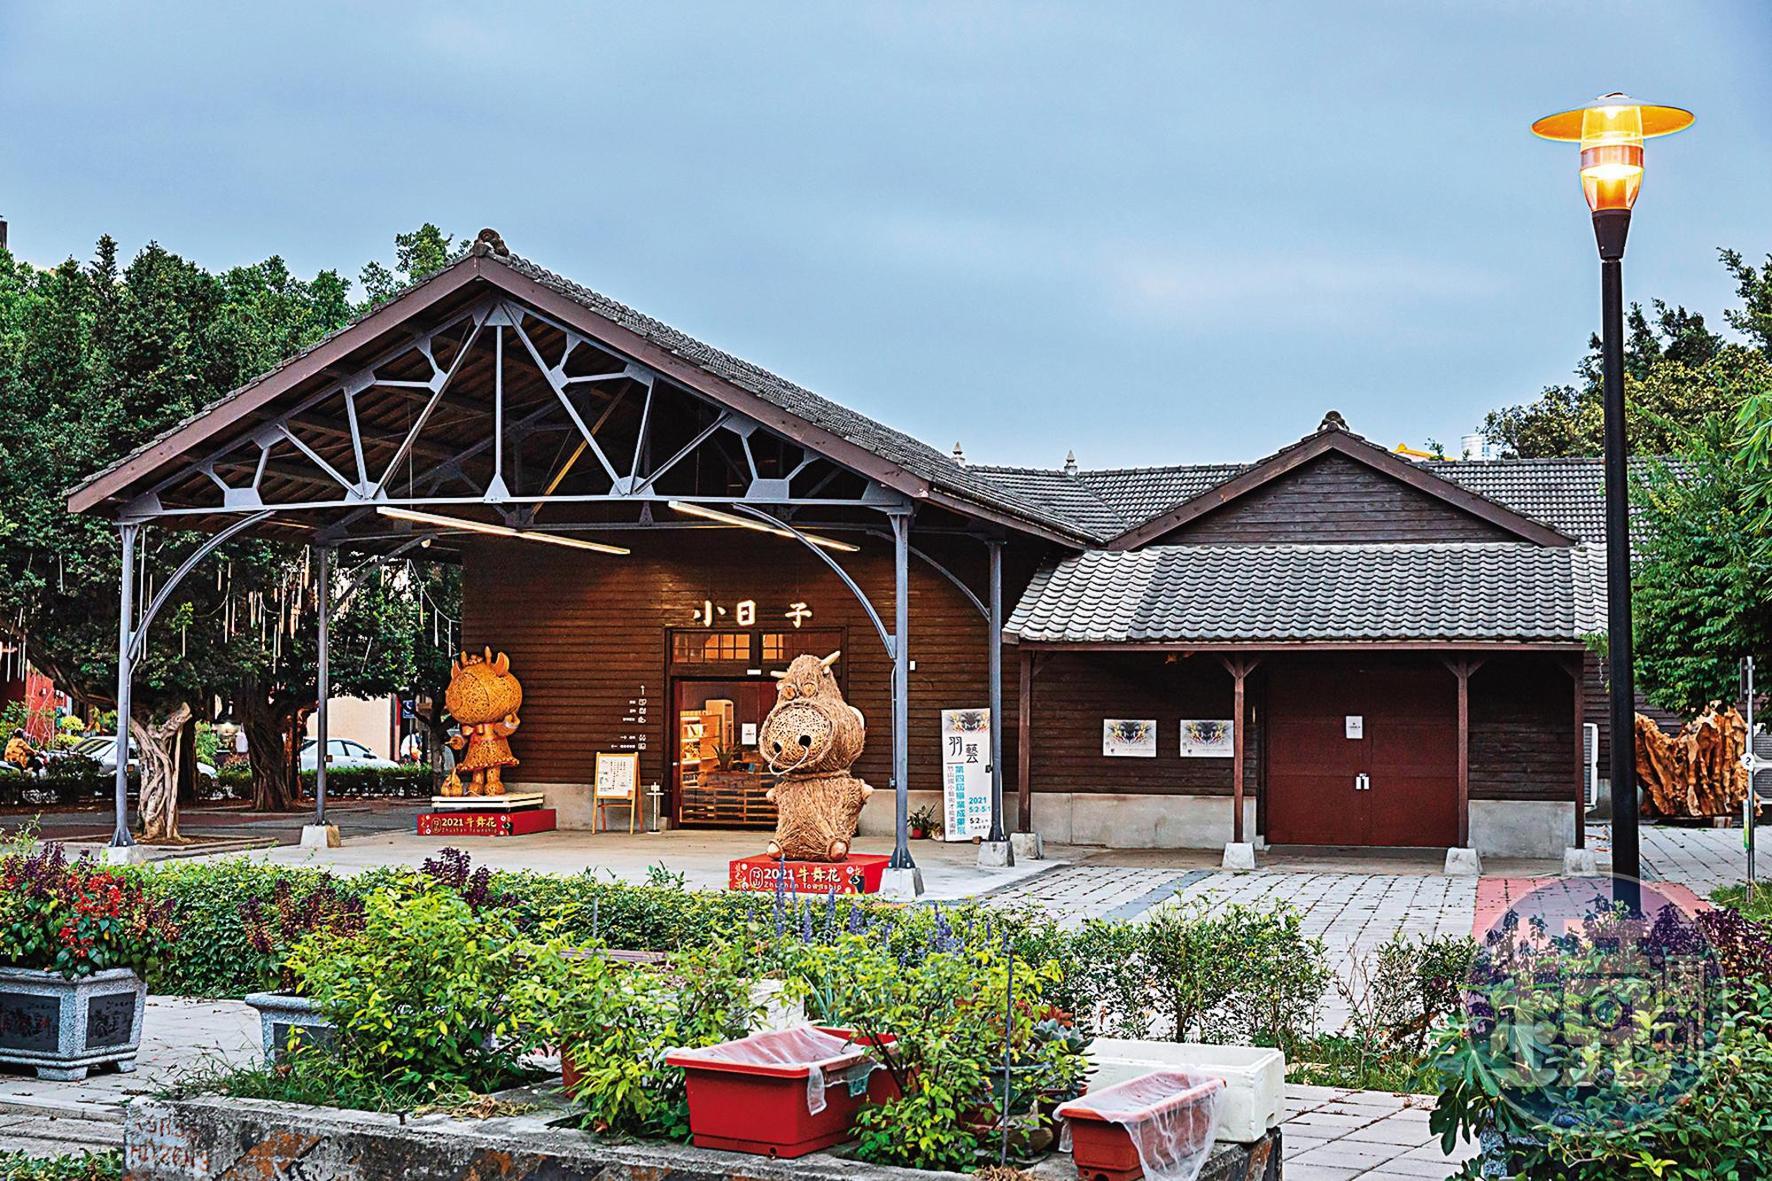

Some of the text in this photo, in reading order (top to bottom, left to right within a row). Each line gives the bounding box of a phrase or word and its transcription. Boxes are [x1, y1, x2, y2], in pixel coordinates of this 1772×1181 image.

[693, 600, 812, 628] 小日子
[1745, 756, 1752, 766] 2
[442, 818, 464, 827] 2021
[763, 868, 794, 880] 2021
